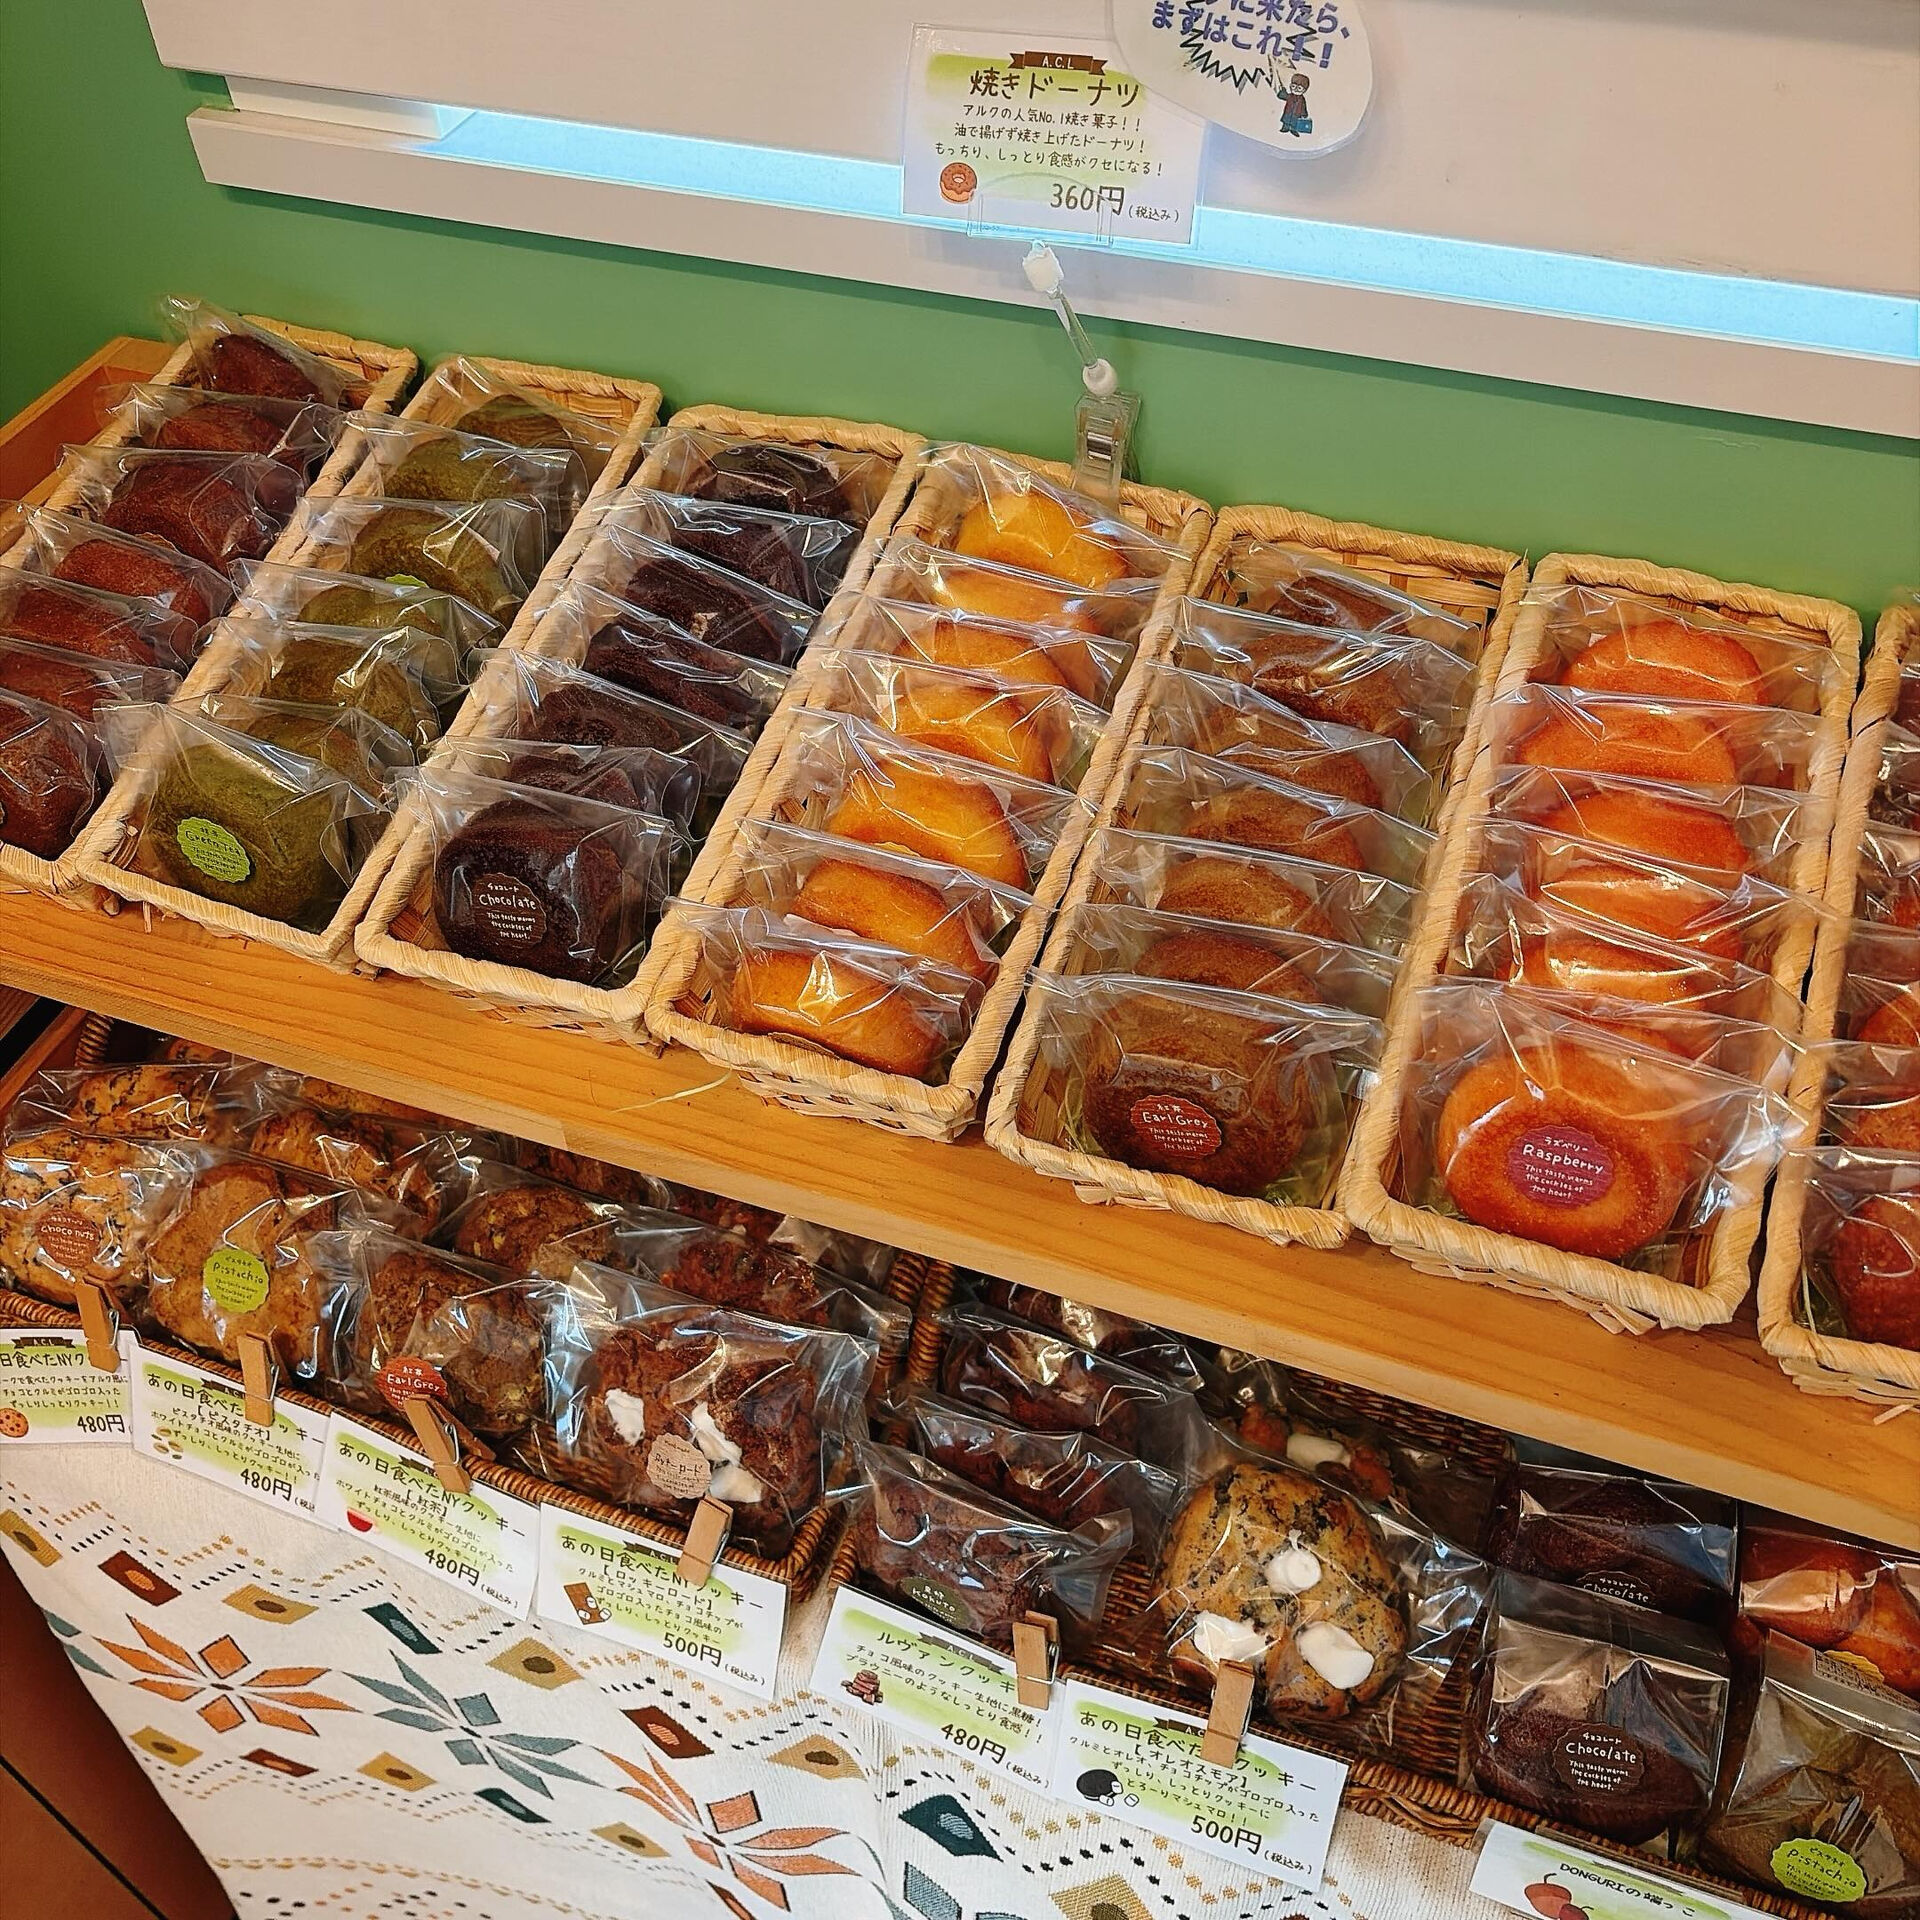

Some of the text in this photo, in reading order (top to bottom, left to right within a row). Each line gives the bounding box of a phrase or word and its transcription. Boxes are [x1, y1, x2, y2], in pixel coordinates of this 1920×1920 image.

[1206, 0, 1350, 39] に来たら、
[1041, 56, 1075, 69] A.C.L
[969, 67, 1140, 107] 焼きドーナツ
[954, 123, 1145, 153] 油で揚げず焼き上げたドーナツ！
[935, 142, 1163, 176] もっちり、しっとり食感がクセになる！
[1050, 184, 1125, 216] 360円
[479, 893, 536, 910] Chocolate
[1142, 1111, 1209, 1129] Earl Grey
[1522, 1143, 1604, 1174] Raspberry
[1544, 1136, 1589, 1152] ラズベリー
[1525, 1164, 1593, 1186] This taste warms
[1526, 1173, 1540, 1182] the
[213, 1262, 263, 1284] Pistachio
[0, 1351, 128, 1368] 日食べたNYクー
[387, 1373, 440, 1392] Earl Grey
[77, 1414, 125, 1433] 480円
[147, 1373, 325, 1445] あの日食べたッキー
[240, 1468, 293, 1502] 480円
[339, 1442, 525, 1537] あの日食べたNYクッキー
[424, 1548, 480, 1587] 480円
[663, 1632, 722, 1668] 500円
[877, 1632, 1016, 1694] ルヴァンクッキ
[940, 1723, 1007, 1765] 480円
[1080, 1711, 1316, 1791] あの日食べたクッキー
[1565, 1742, 1637, 1764] Chocolate
[1569, 1759, 1584, 1768] This
[1190, 1815, 1262, 1855] 500円
[1786, 1848, 1857, 1888] Pistachio
[1560, 1863, 1696, 1917] DONGURIの端っこ
